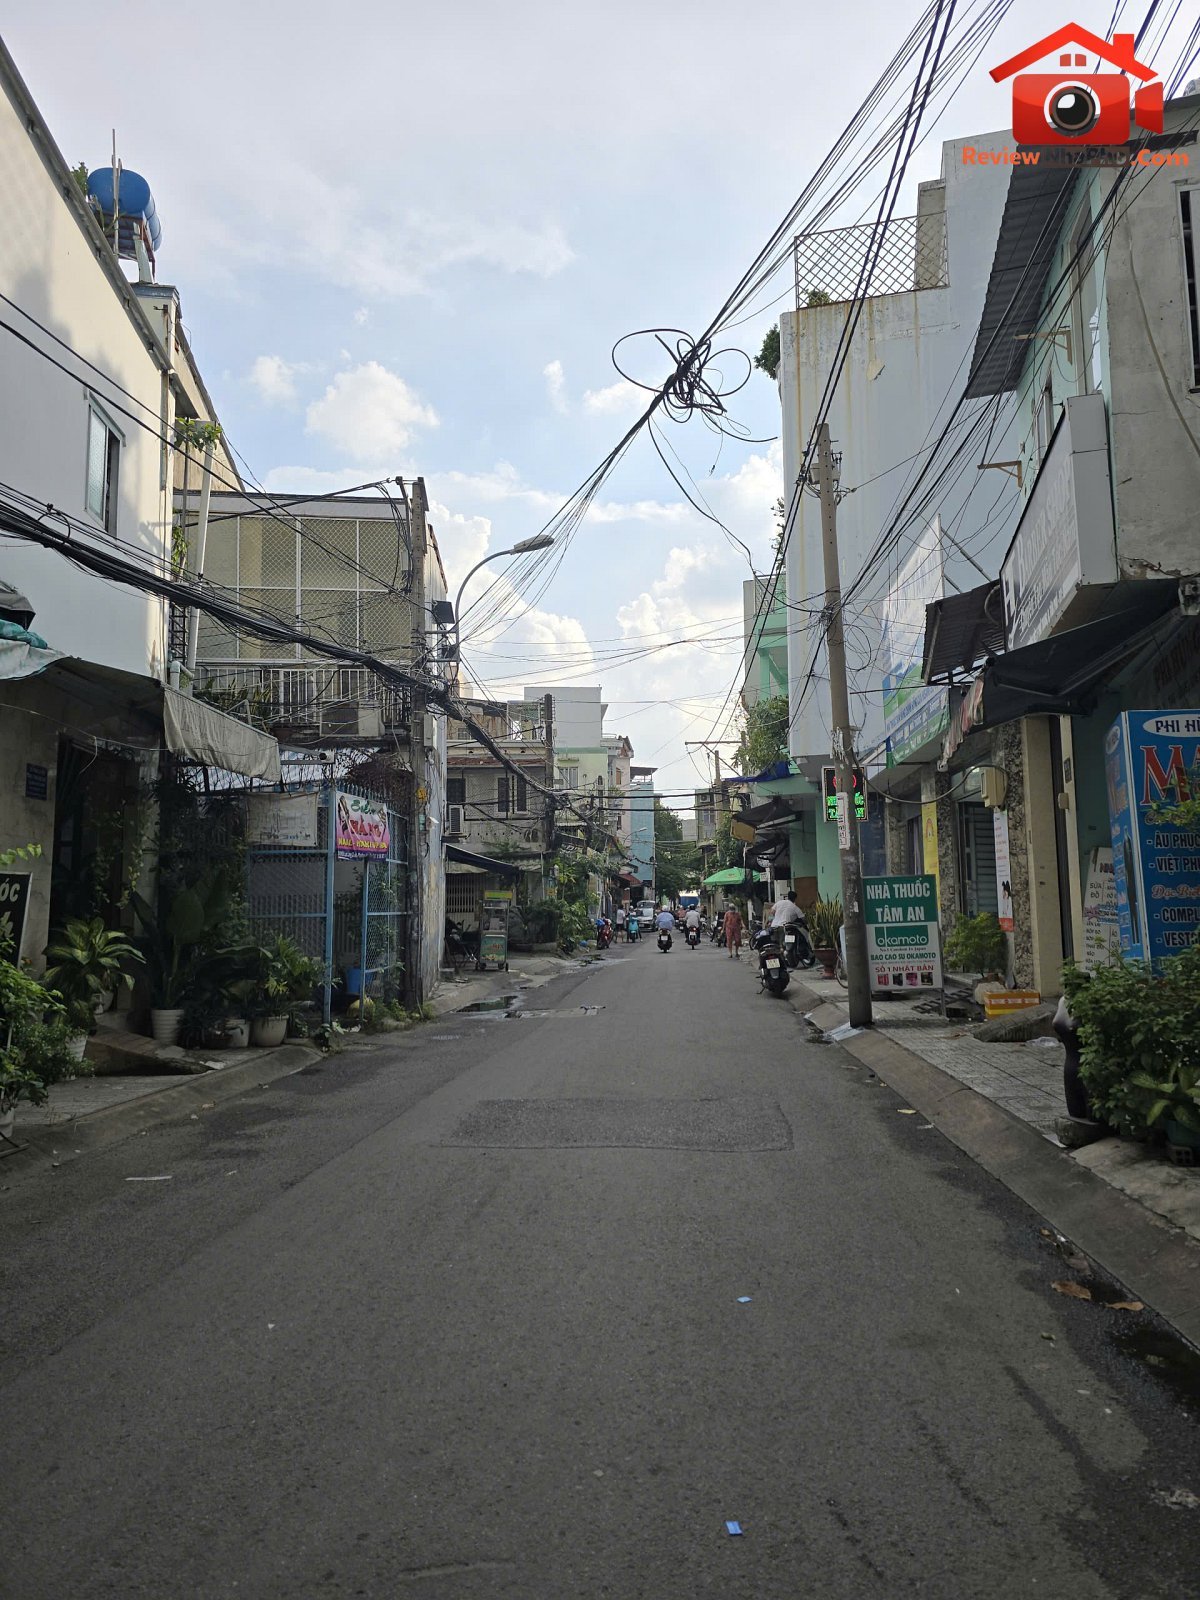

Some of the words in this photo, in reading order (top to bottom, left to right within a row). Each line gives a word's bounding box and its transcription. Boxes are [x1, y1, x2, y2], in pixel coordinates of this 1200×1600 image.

[1155, 720, 1180, 733] PHI
[866, 881, 891, 900] NHÀ
[893, 878, 930, 899] THUỐC
[876, 905, 903, 922] TÂM
[907, 906, 925, 921] AN
[877, 929, 928, 947] okamoto
[906, 952, 936, 960] OKAMOTO
